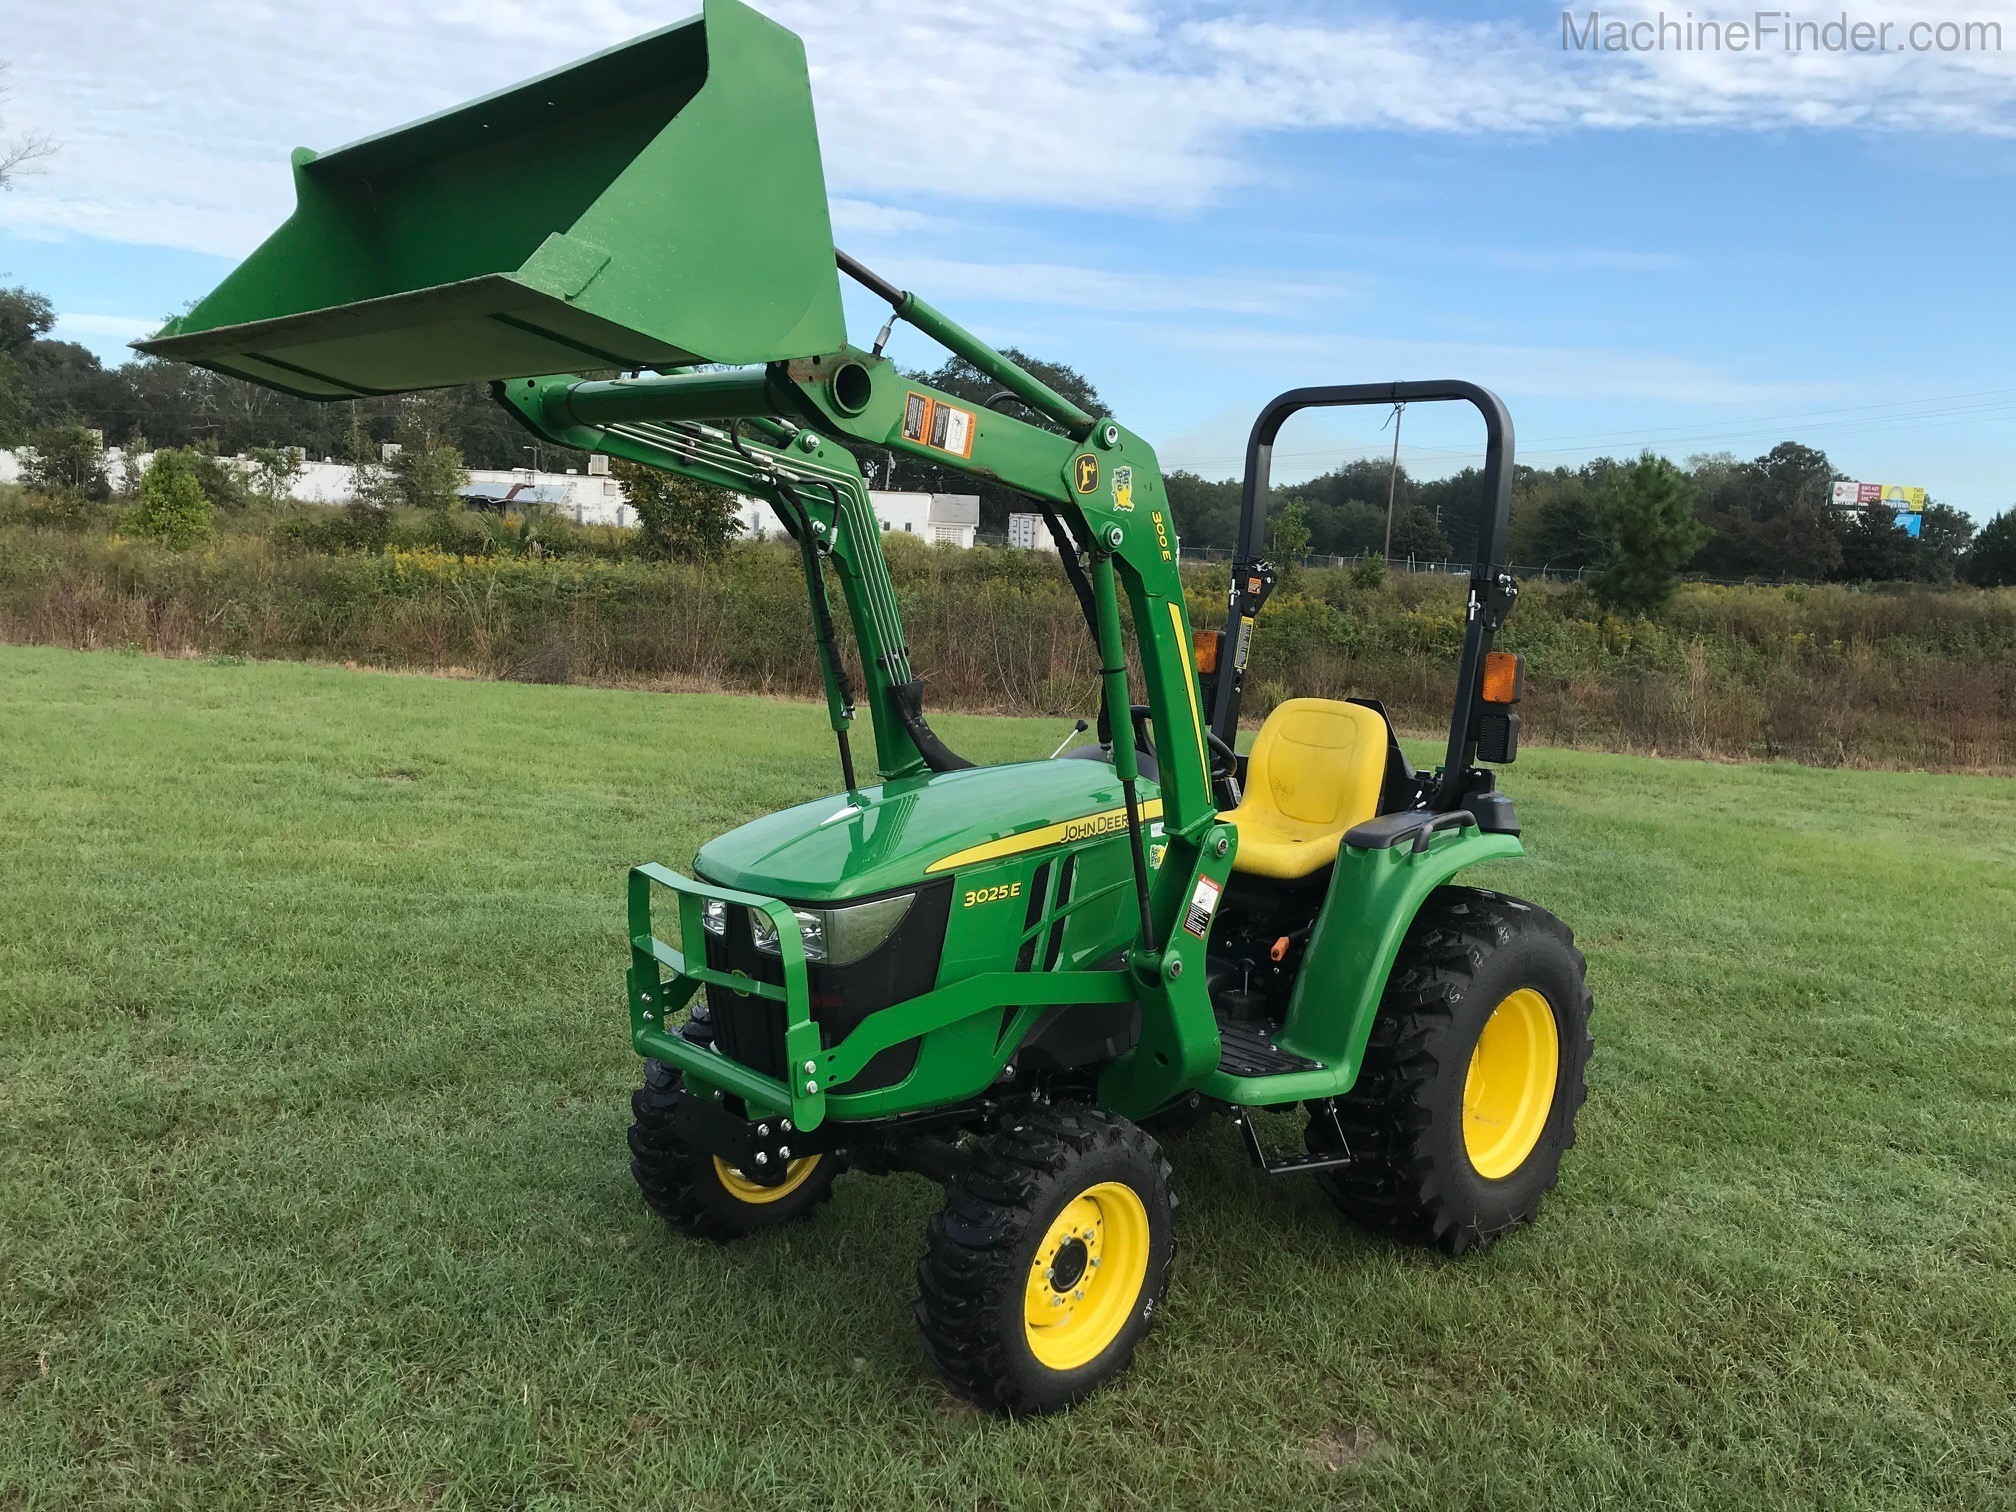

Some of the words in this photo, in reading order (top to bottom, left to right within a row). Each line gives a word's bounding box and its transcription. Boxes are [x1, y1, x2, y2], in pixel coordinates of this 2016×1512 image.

[1060, 820, 1096, 842] JOHN
[1097, 814, 1129, 832] DEER
[963, 882, 1022, 908] 3025E
